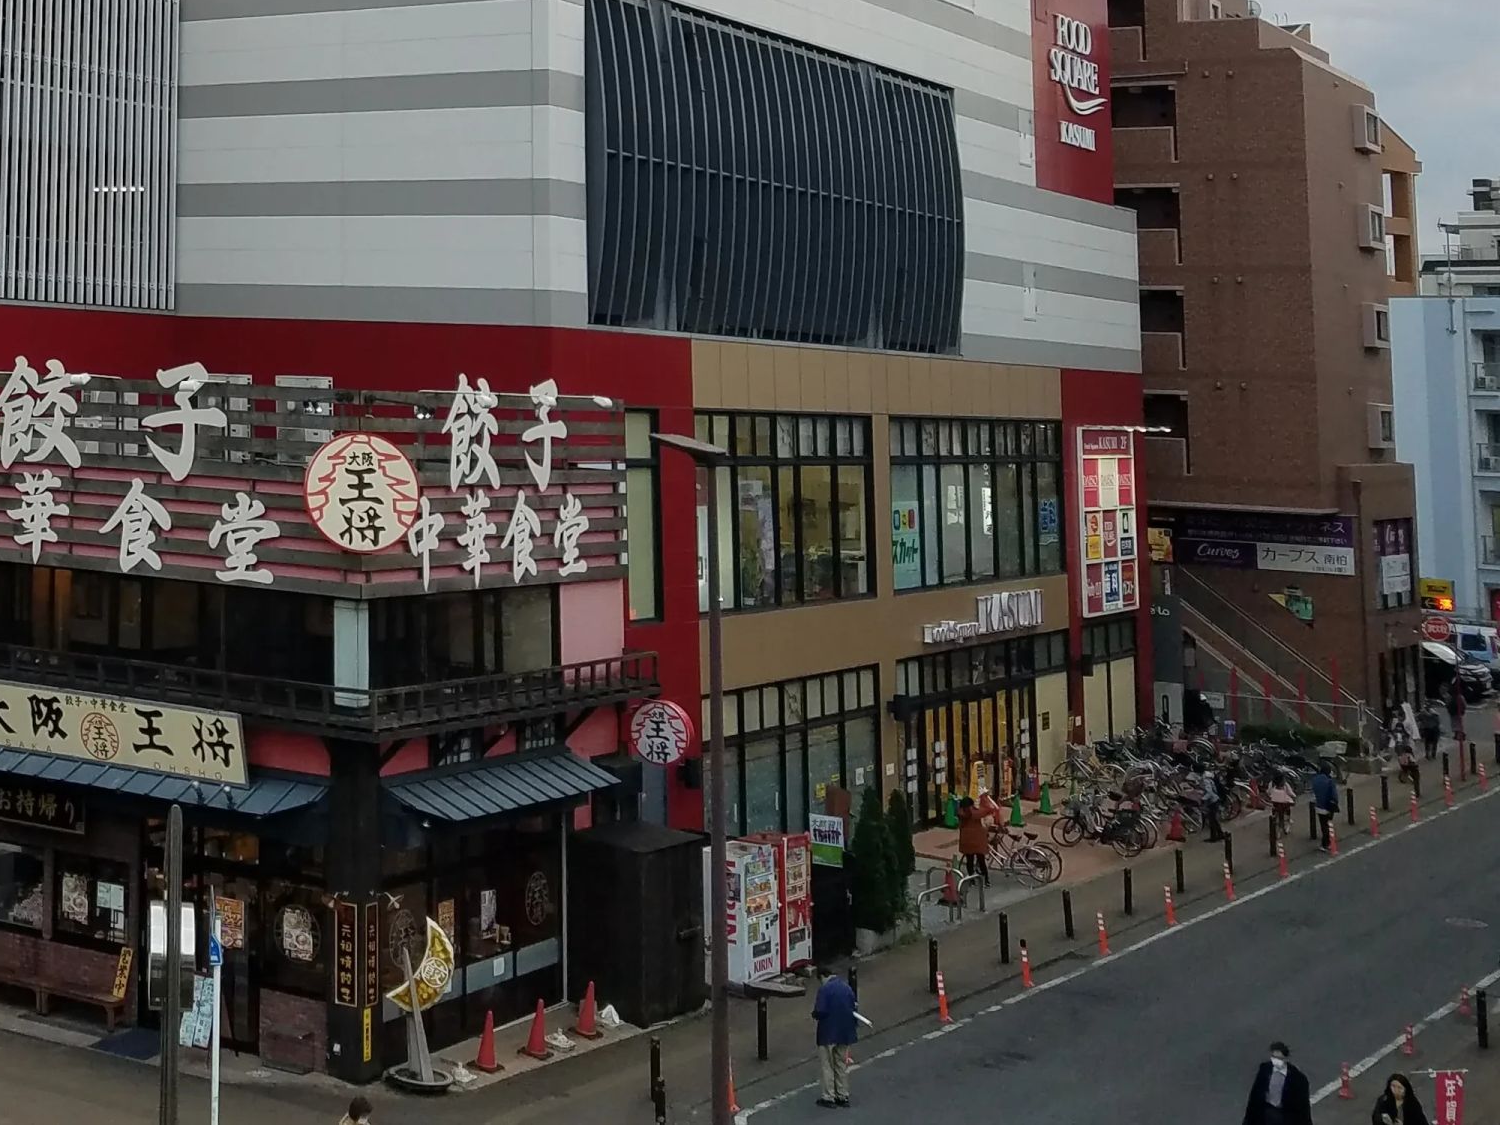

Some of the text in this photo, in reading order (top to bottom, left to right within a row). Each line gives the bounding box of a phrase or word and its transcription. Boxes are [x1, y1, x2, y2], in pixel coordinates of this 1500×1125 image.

[1056, 13, 1092, 56] FOOD
[1049, 48, 1100, 96] SQUARE
[1059, 120, 1097, 152] KASUMI
[441, 372, 568, 493] 餃子
[347, 451, 374, 468] 大阪
[338, 467, 386, 547] 王将
[406, 489, 590, 593] 中華食堂
[1196, 543, 1241, 560] Curves
[1261, 548, 1320, 566] カーブス
[132, 707, 235, 768] 王将
[645, 719, 671, 764] 王将
[753, 956, 774, 974] KIRIN
